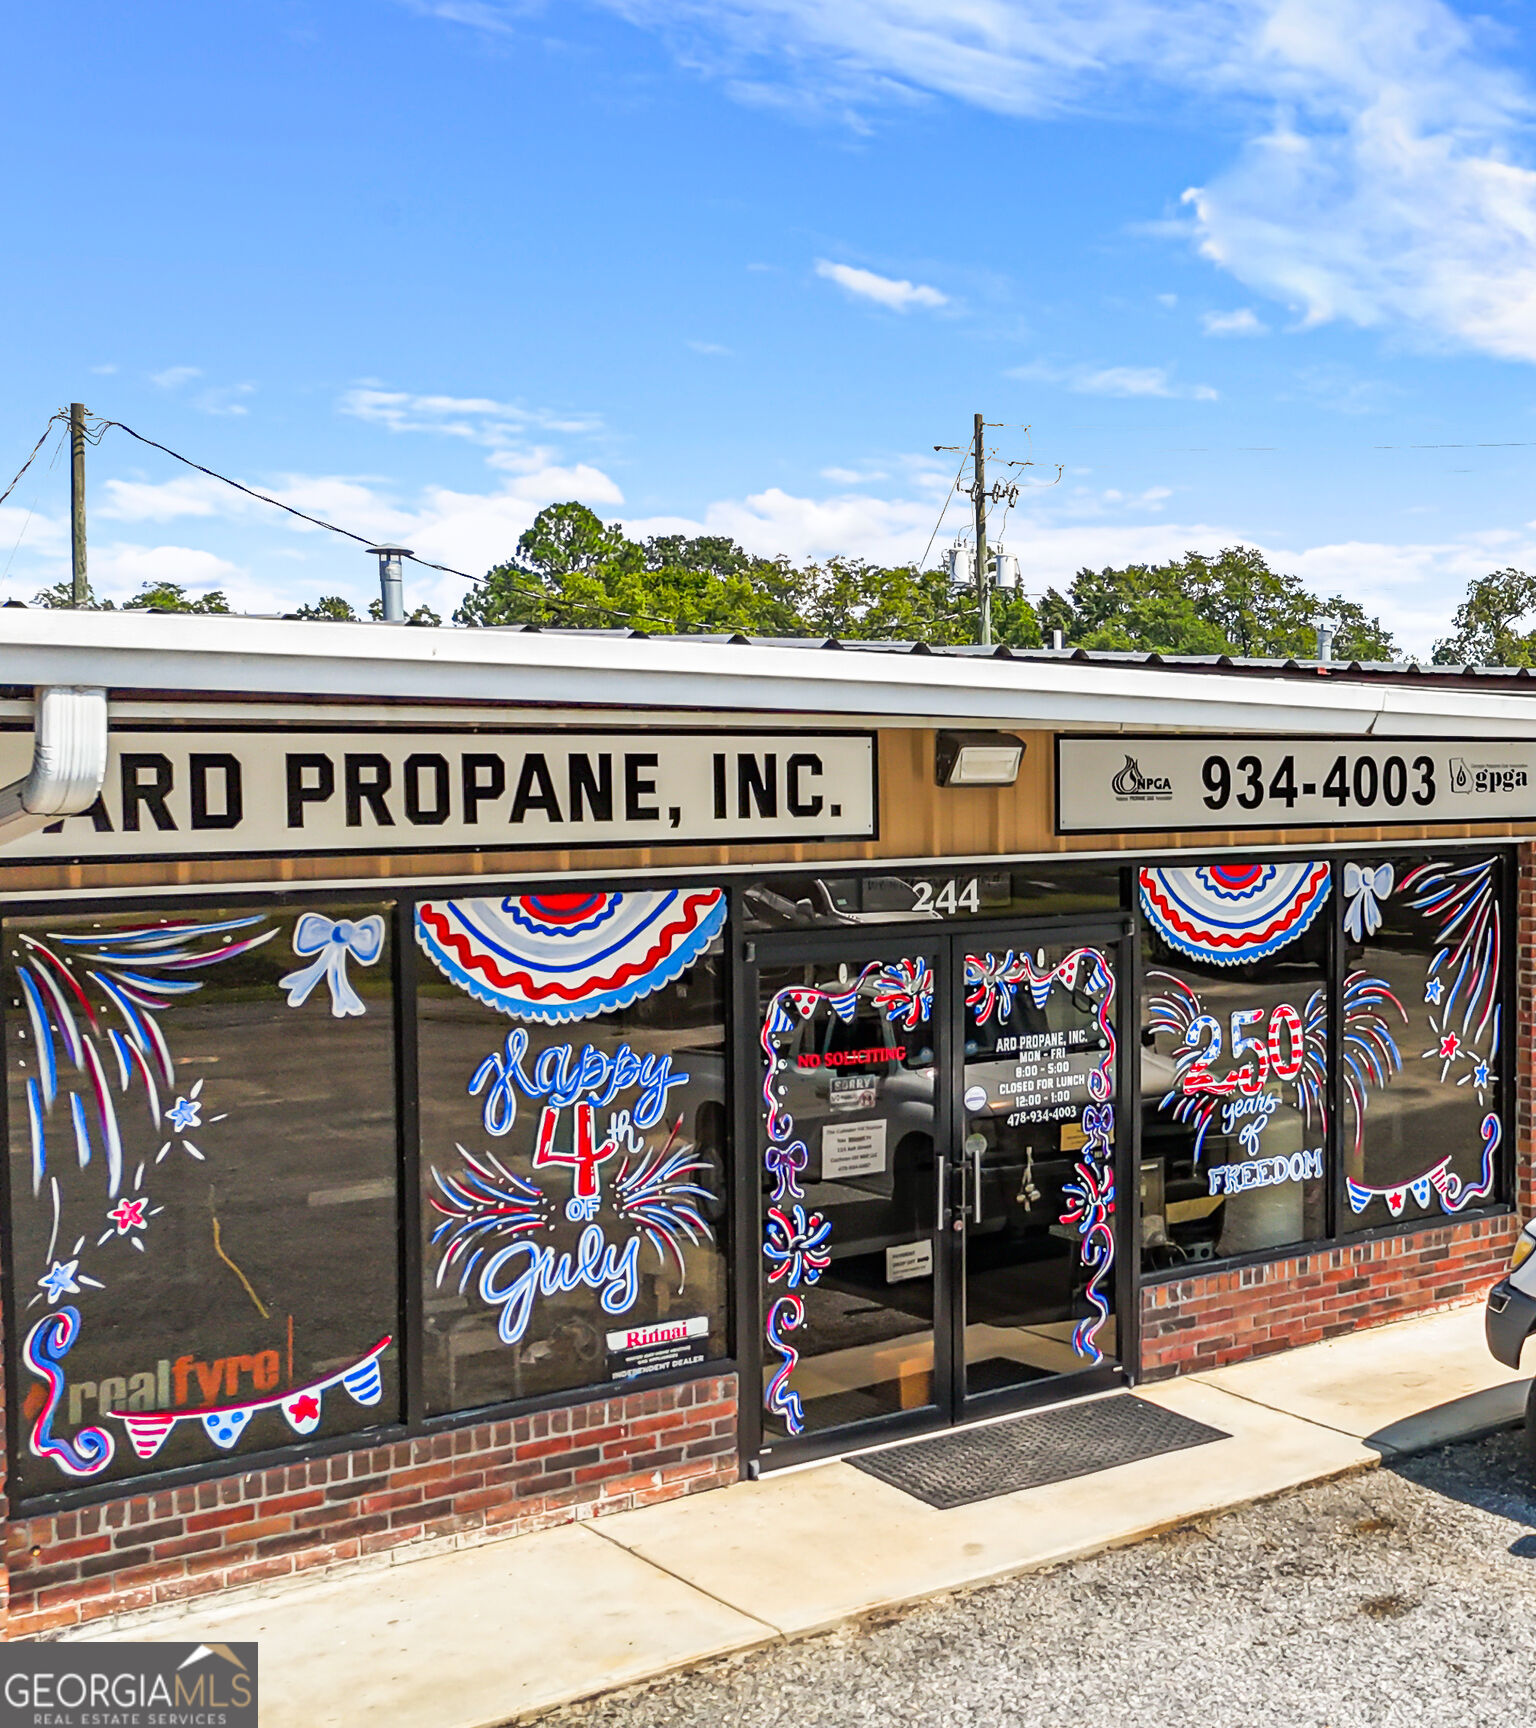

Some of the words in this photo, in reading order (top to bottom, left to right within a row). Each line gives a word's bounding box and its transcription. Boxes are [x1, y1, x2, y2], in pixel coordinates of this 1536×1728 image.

[286, 753, 682, 828] PROPANE,
[713, 753, 842, 818] INC.
[1137, 777, 1172, 790] NPGA
[1202, 755, 1436, 810] 934-4003
[1475, 768, 1528, 793] gpga
[912, 879, 980, 914] 244
[996, 1037, 1017, 1053] ARD
[1019, 1031, 1067, 1050] PROPANE,
[1068, 1029, 1088, 1045] INC.
[1183, 1004, 1304, 1095] 250
[797, 1053, 822, 1068] NO
[824, 1046, 906, 1067] SOLICITING
[1019, 1050, 1041, 1063] MON
[1050, 1047, 1066, 1060] FRI
[468, 1027, 690, 1136] Happy
[1015, 1065, 1038, 1078] 8:00
[1047, 1061, 1070, 1074] 5:00
[834, 1078, 870, 1091] SORRY
[1000, 1078, 1035, 1095] CLOSED
[1036, 1077, 1054, 1091] FOR
[1056, 1074, 1085, 1088] LUNCH
[1015, 1092, 1042, 1108] 12:00
[1051, 1090, 1071, 1104] 1:00
[1007, 1105, 1077, 1127] 478-934-4003
[1222, 1091, 1282, 1134] years
[1239, 1114, 1268, 1156] of
[1208, 1148, 1323, 1195] FREEDOM
[565, 1197, 601, 1221] OF
[479, 1224, 640, 1344] July
[627, 1322, 688, 1348] Rinnai
[671, 1354, 704, 1368] DEALER
[69, 1350, 279, 1424] realfyre
